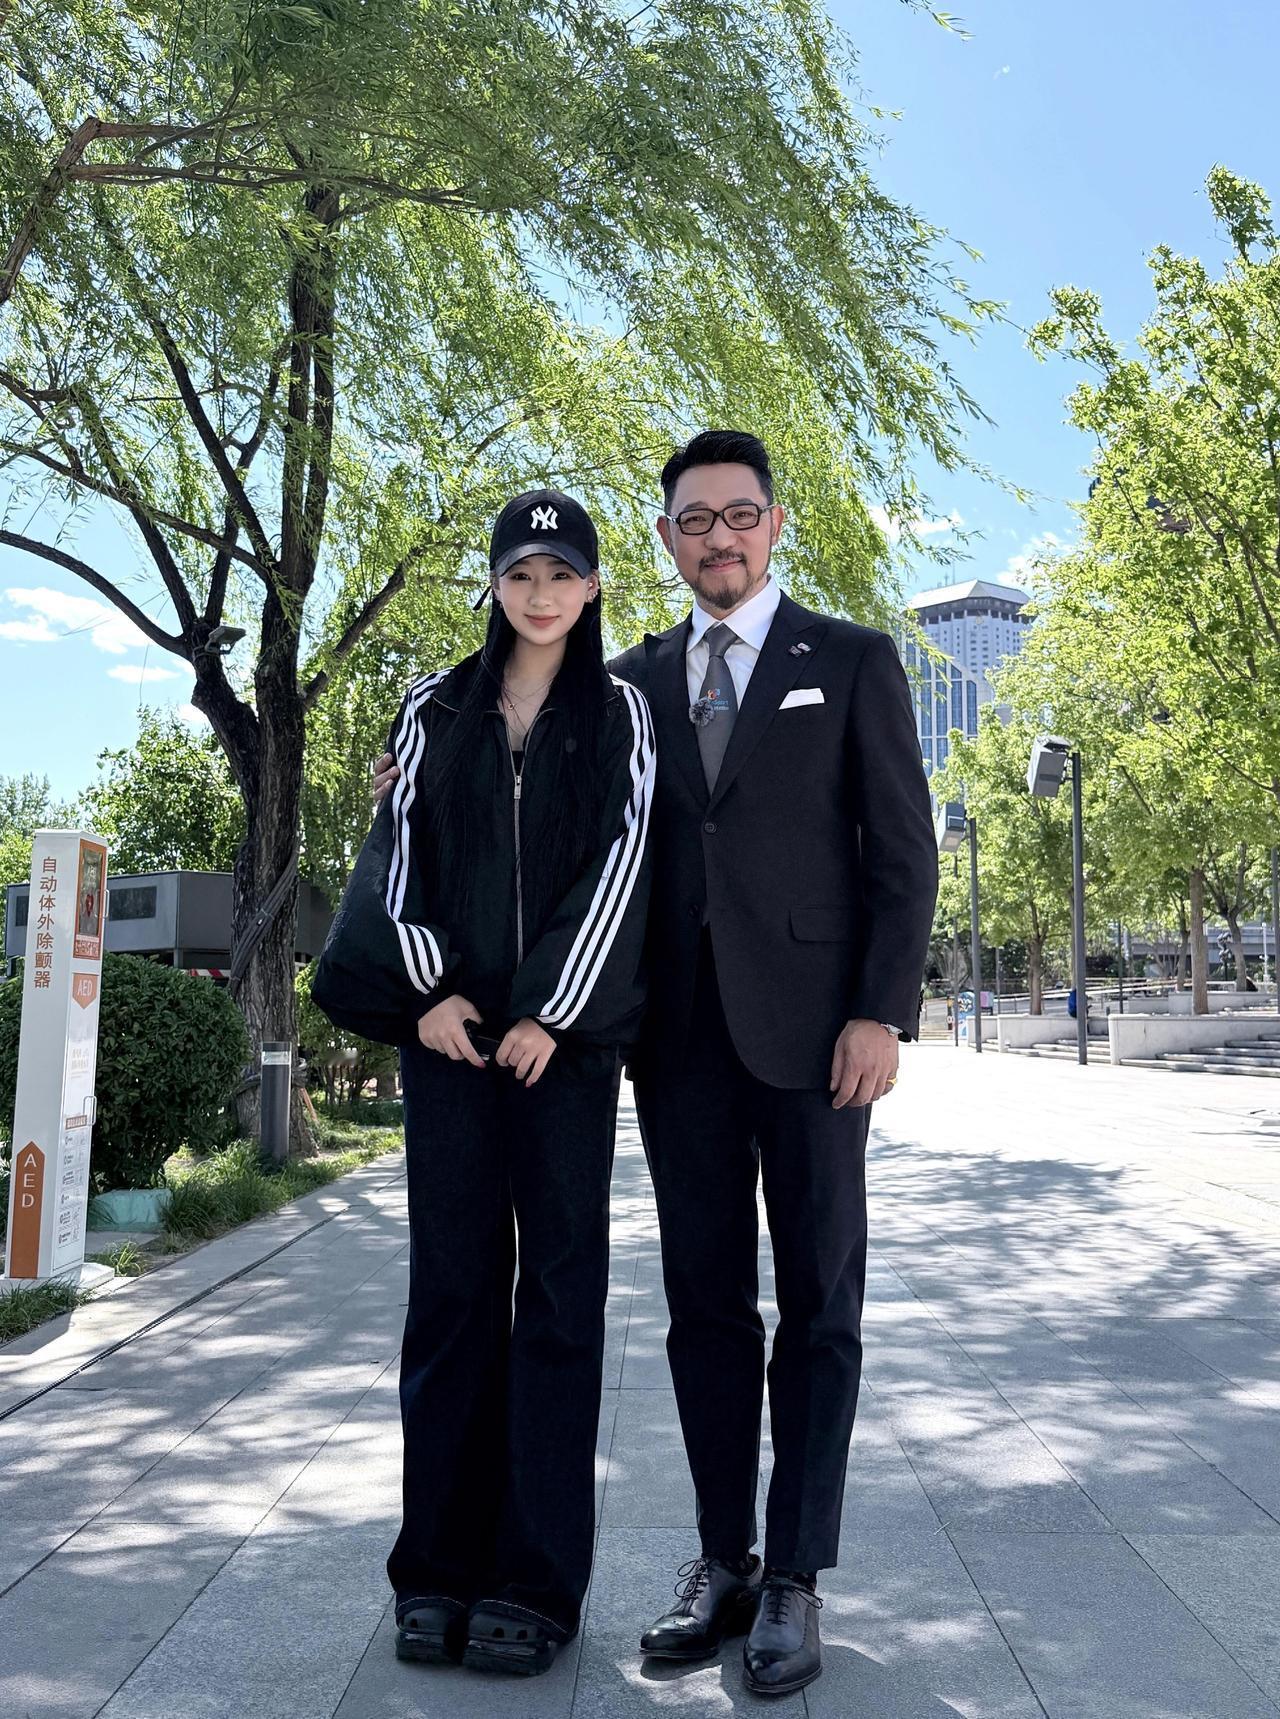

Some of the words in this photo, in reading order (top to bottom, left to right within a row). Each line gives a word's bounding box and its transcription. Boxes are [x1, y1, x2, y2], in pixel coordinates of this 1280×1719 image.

[531, 505, 558, 530] NY
[34, 856, 57, 988] 自动体外除颤器
[77, 979, 93, 997] AED
[21, 1154, 37, 1208] AED
